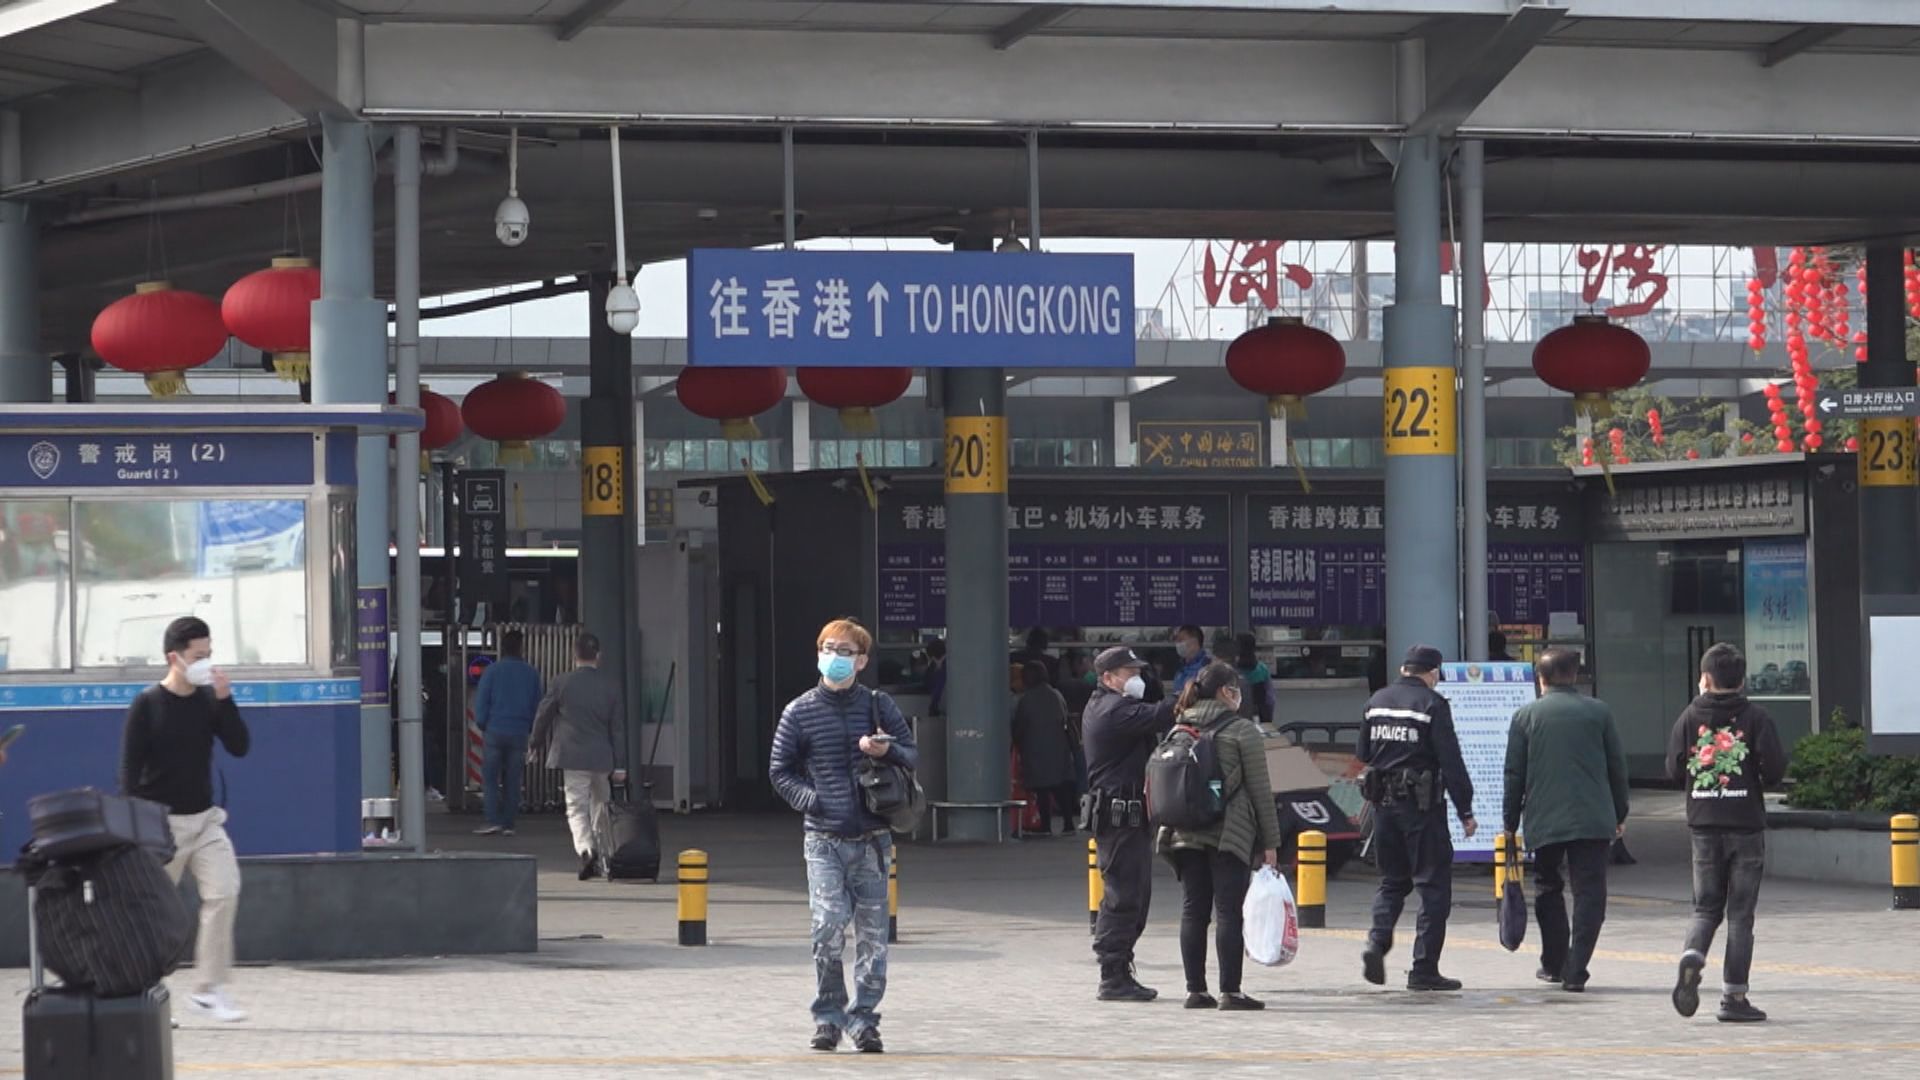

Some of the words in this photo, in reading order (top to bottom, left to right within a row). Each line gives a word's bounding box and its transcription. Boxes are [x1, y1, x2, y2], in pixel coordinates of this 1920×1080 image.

[709, 276, 851, 339] 往香港
[904, 284, 942, 333] TO
[951, 284, 1121, 335] HONGKONG
[1391, 387, 1430, 437] 22
[1843, 391, 1914, 406] 口岸大厅出入口
[950, 433, 983, 478] 20
[1180, 430, 1255, 453] 中国海关
[1869, 429, 1903, 471] 23
[584, 462, 612, 502] 18
[902, 505, 1206, 529] 香港直巴·机场小车票务
[1250, 549, 1315, 582] 香港国际机场
[1376, 724, 1408, 742] POLICE
